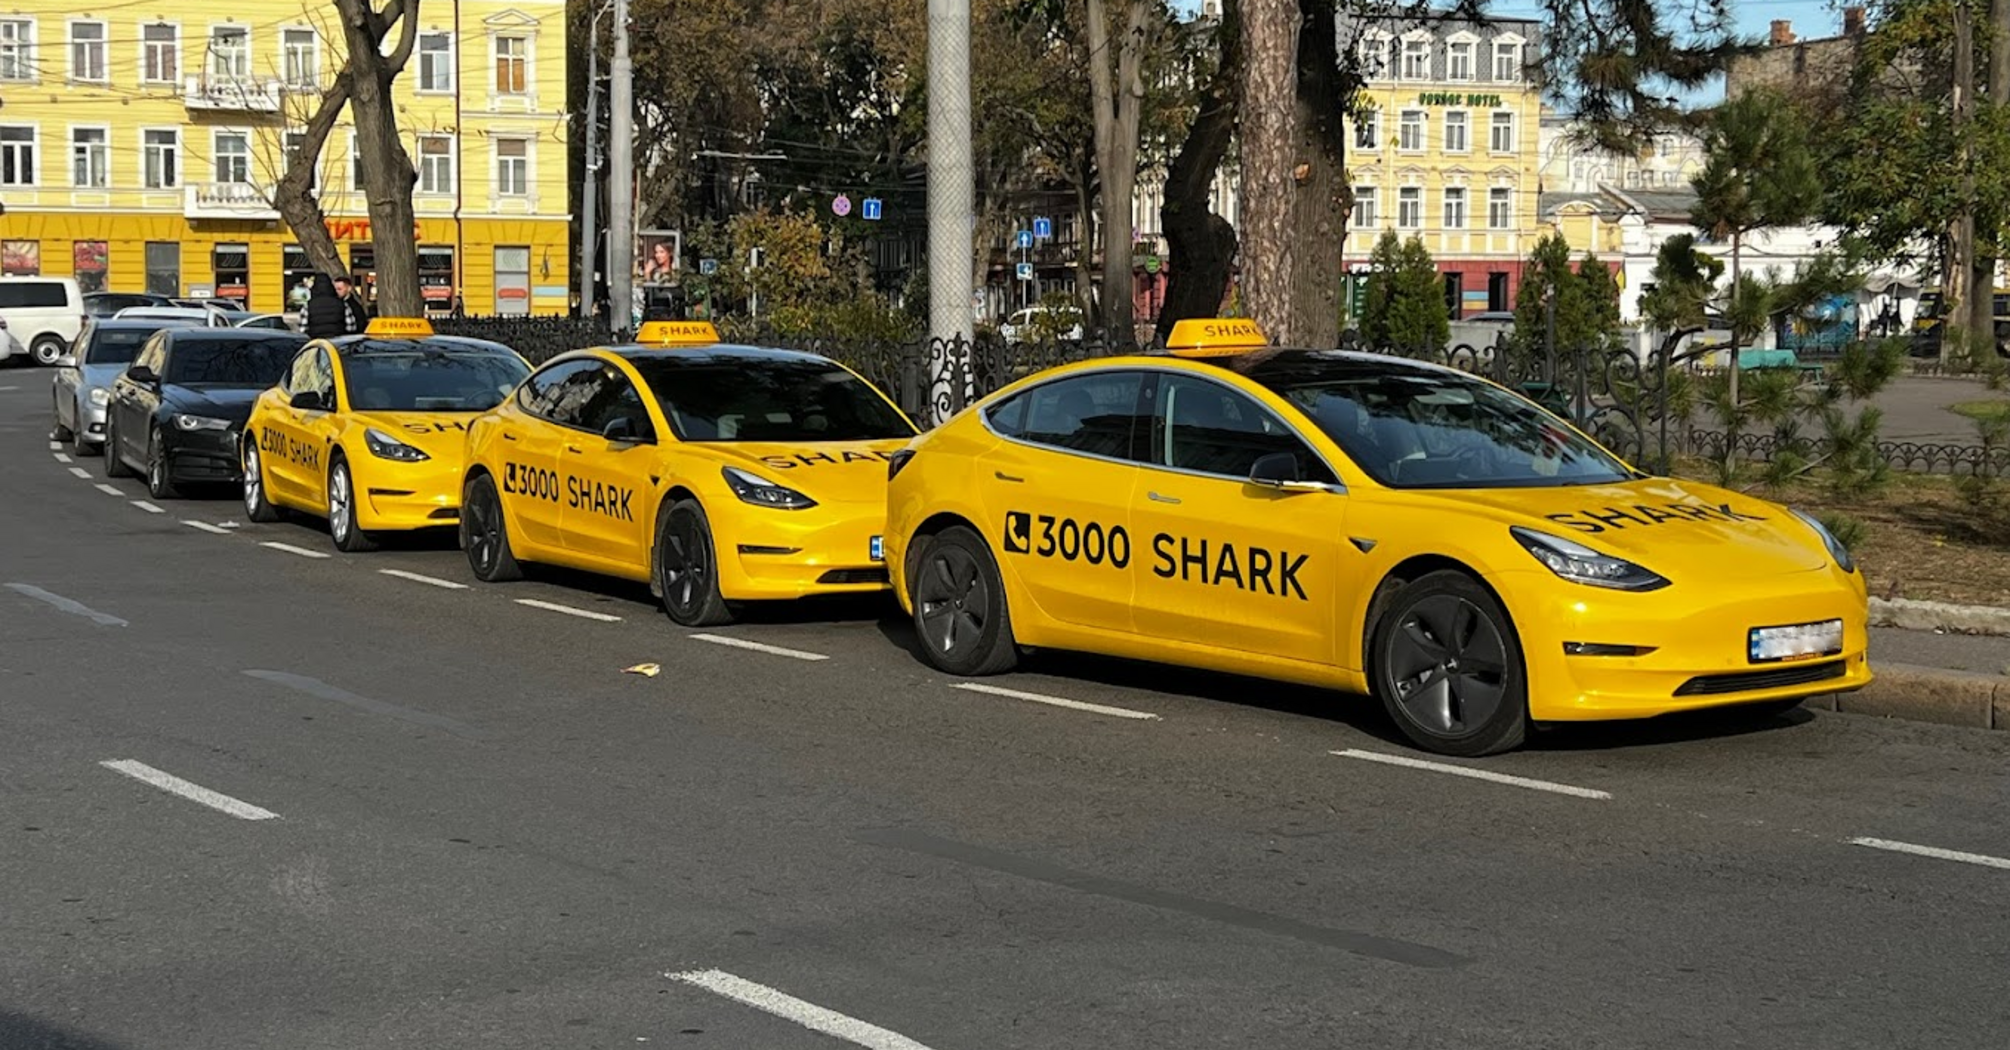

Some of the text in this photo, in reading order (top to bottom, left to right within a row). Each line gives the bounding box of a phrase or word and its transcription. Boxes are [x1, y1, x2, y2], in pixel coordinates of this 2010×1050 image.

[1466, 94, 1502, 107] HOTEL
[380, 320, 424, 330] SHARK
[659, 326, 711, 336] SHARK
[1204, 325, 1261, 337] SHARK
[269, 428, 320, 474] 3000 SHARK
[760, 451, 890, 469] SHA
[519, 464, 634, 523] 3000 SHARK
[1544, 503, 1768, 533] SHARK
[1037, 514, 1310, 602] 3000 SHARK
